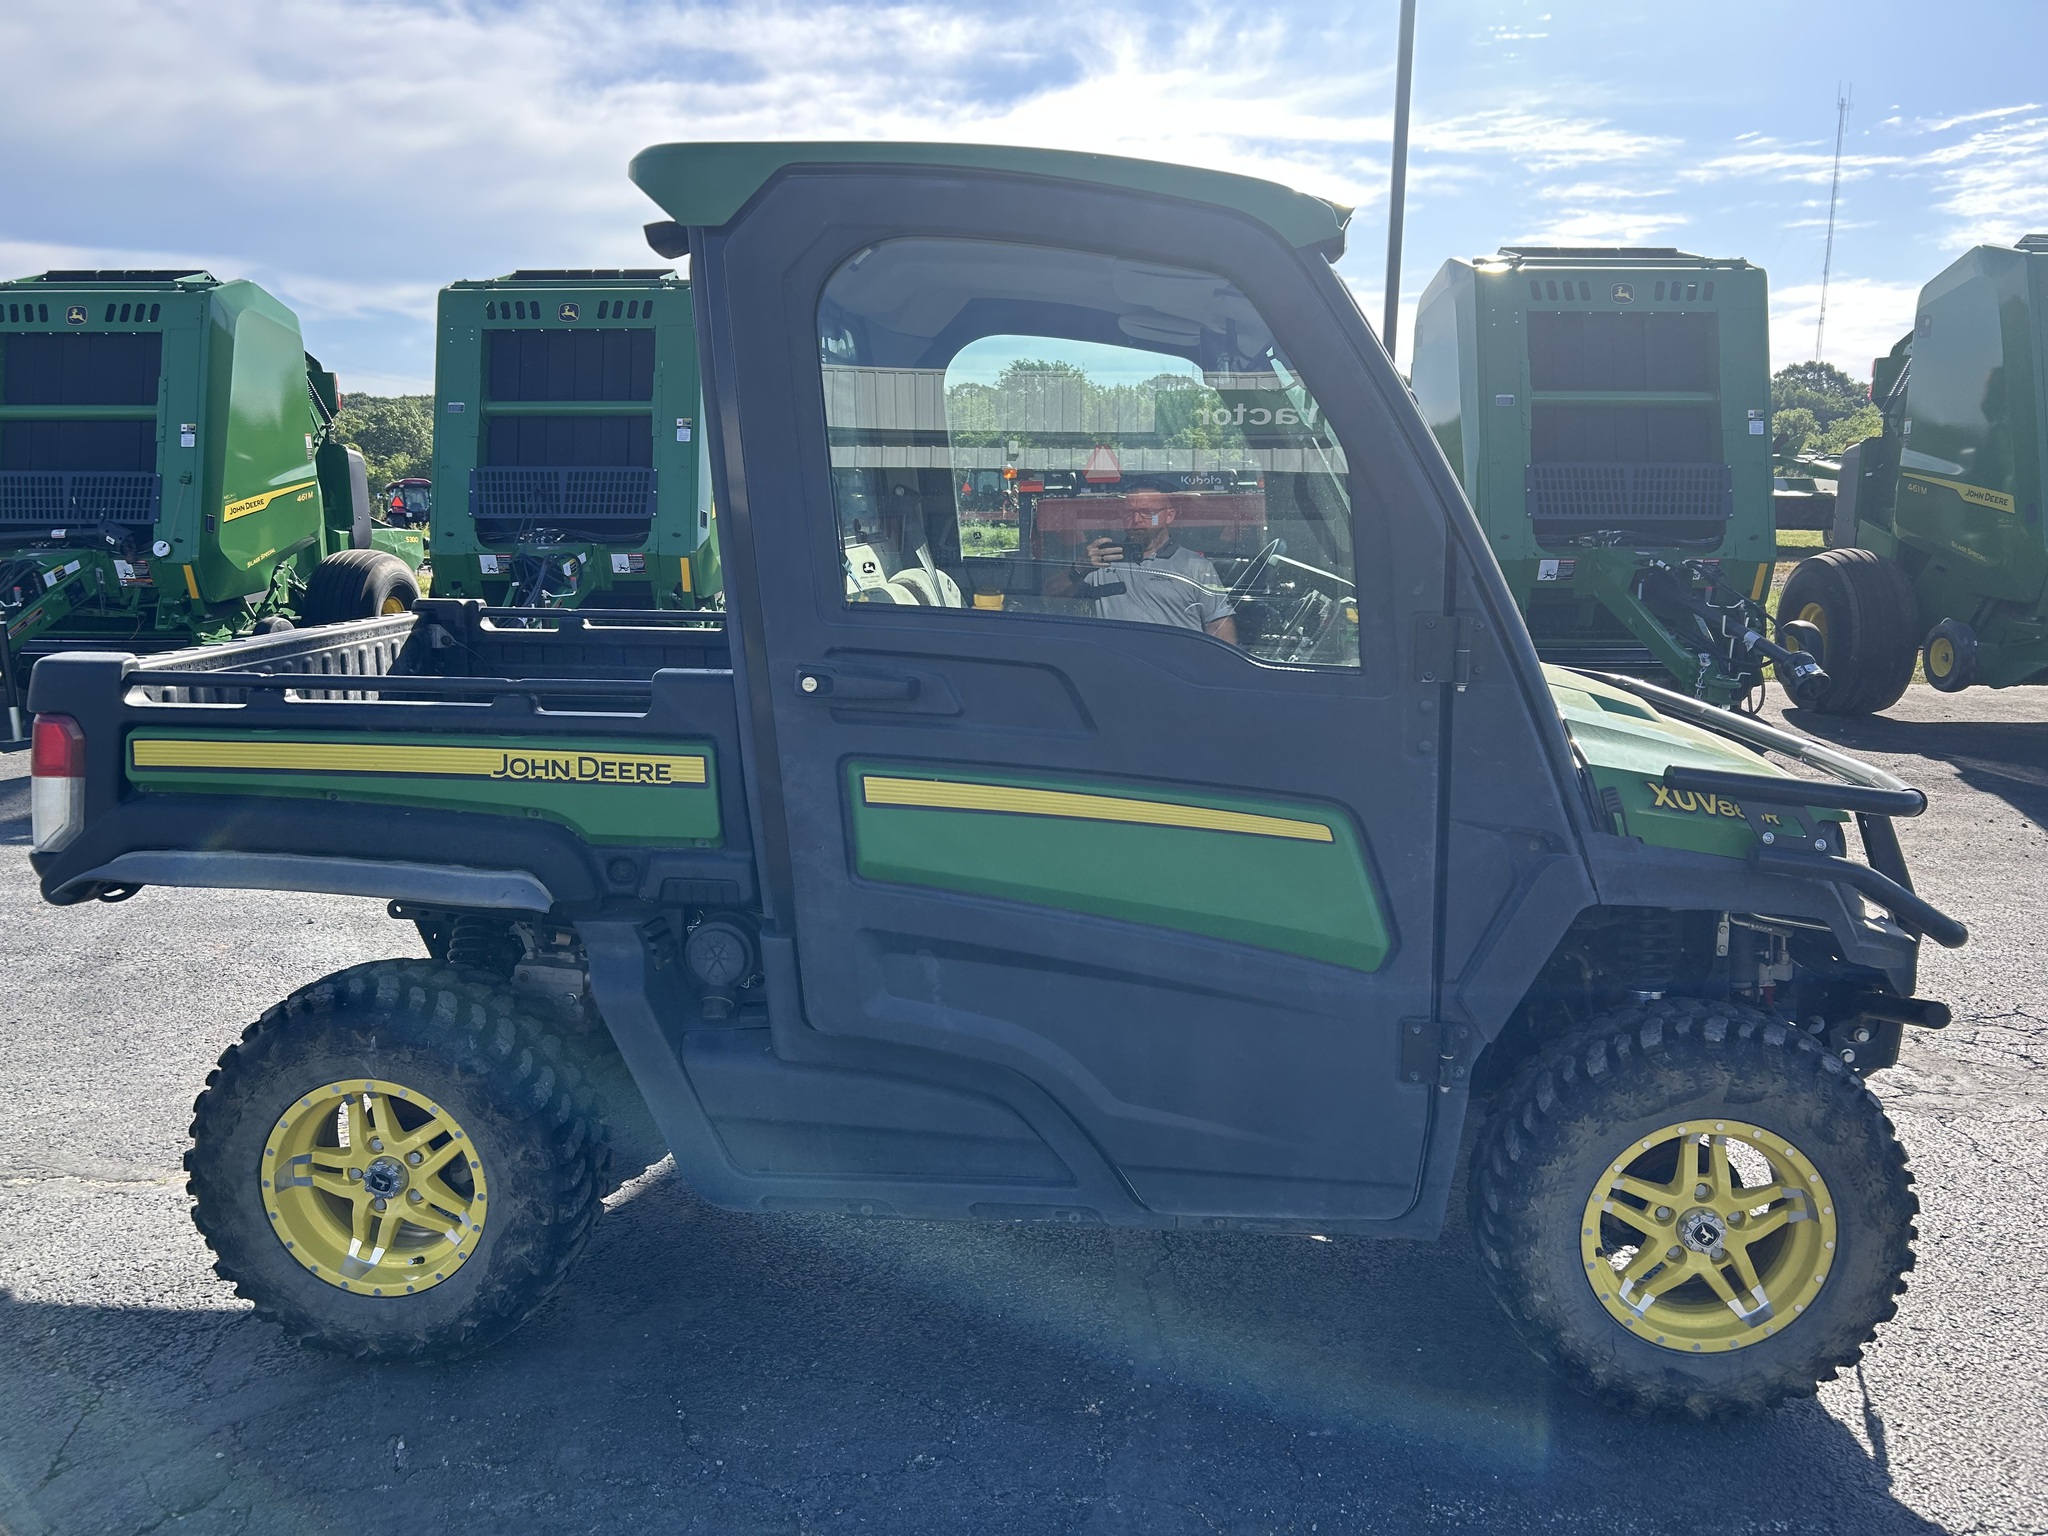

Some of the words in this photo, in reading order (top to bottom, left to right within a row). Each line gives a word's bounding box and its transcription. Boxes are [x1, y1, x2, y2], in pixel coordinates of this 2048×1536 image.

[1180, 475, 1222, 485] Kubota
[1965, 488, 1985, 500] JOHN
[1984, 492, 2009, 506] DEERE
[229, 505, 246, 515] JOHN
[245, 498, 265, 510] DEERE
[492, 754, 571, 778] JOHN
[576, 756, 674, 782] DEERE
